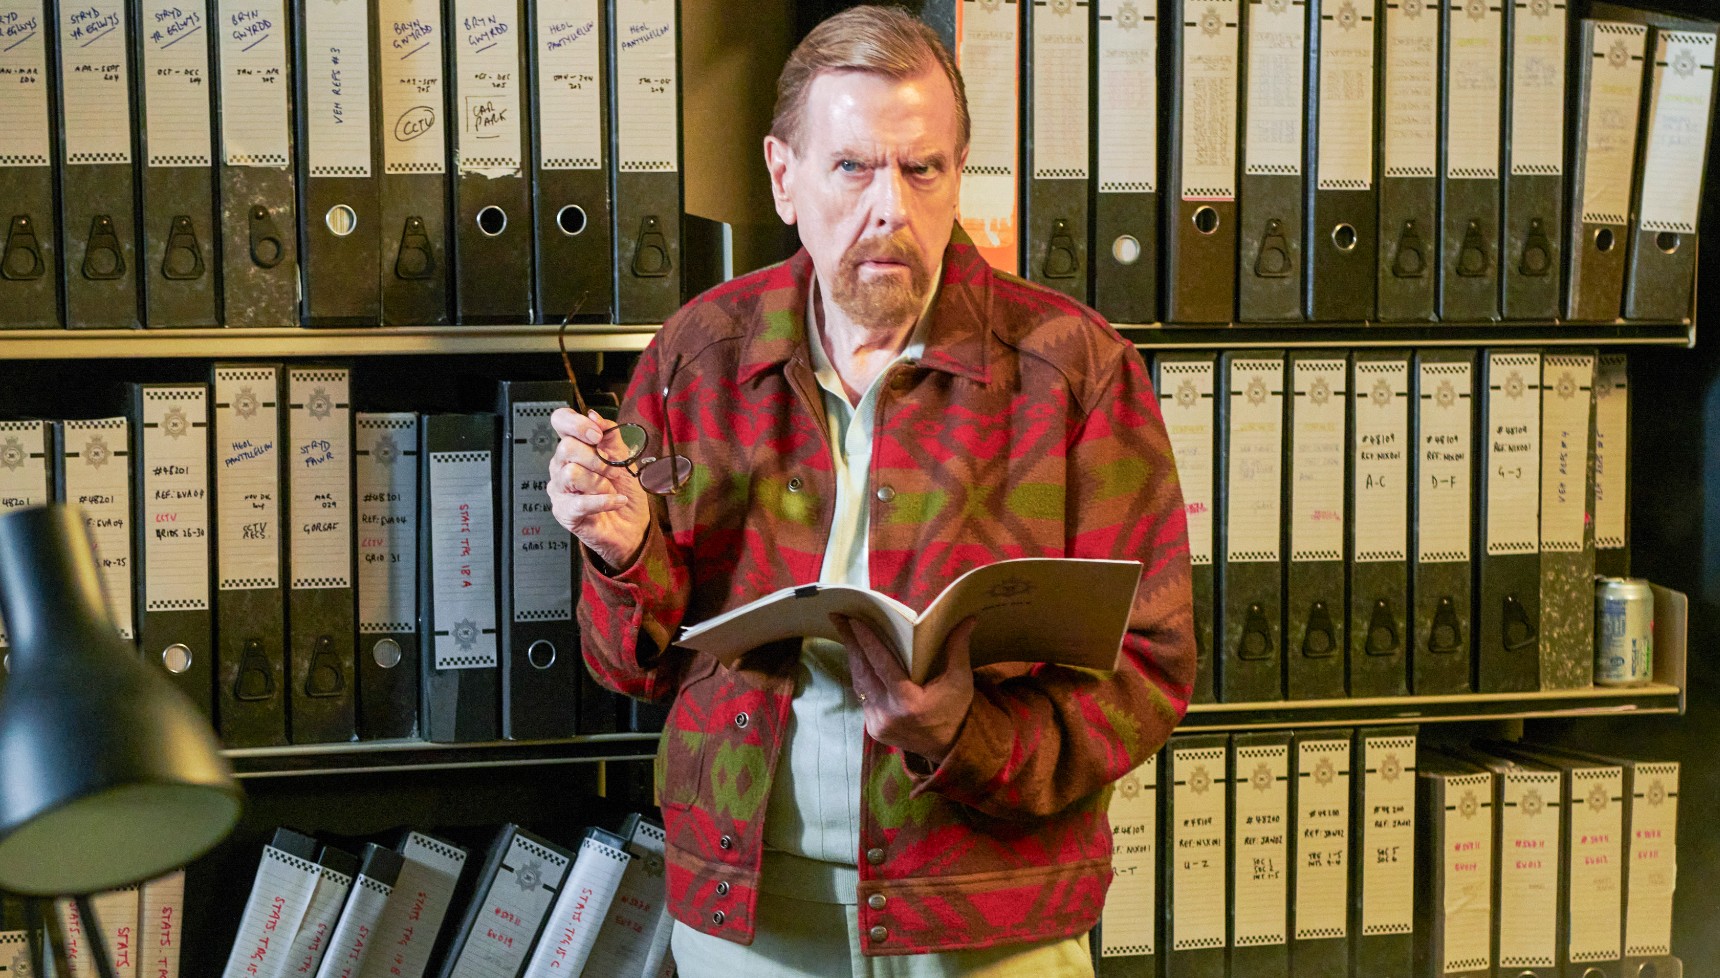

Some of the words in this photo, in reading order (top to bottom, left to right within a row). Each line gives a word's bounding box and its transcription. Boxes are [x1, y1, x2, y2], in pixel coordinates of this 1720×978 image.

[70, 7, 100, 24] STRYD
[154, 7, 182, 22] STRYD
[231, 10, 259, 26] BRYN
[6, 17, 37, 36] EGLWYS
[70, 27, 84, 40] YR
[85, 12, 120, 34] EGLWYS
[150, 31, 164, 43] YR
[167, 12, 201, 36] EGLWYS
[232, 19, 272, 41] GWYRDD
[393, 19, 420, 36] BRYN
[464, 15, 497, 31] BRYN
[549, 22, 573, 34] HEOL
[630, 23, 650, 34] HEOL
[393, 25, 432, 49] GWYRDD
[468, 23, 509, 46] GWYRDD
[333, 102, 344, 125] VEH
[473, 101, 495, 117] CAR
[404, 118, 433, 135] CCTV
[475, 109, 508, 132] PARK
[300, 440, 331, 454] STRYD
[152, 465, 189, 476] #48201
[2, 498, 30, 507] 48201
[79, 495, 114, 504] #48201
[363, 493, 401, 502] #48201
[156, 512, 177, 523] CCTV
[243, 522, 267, 533] CCTV
[462, 580, 472, 588] A
